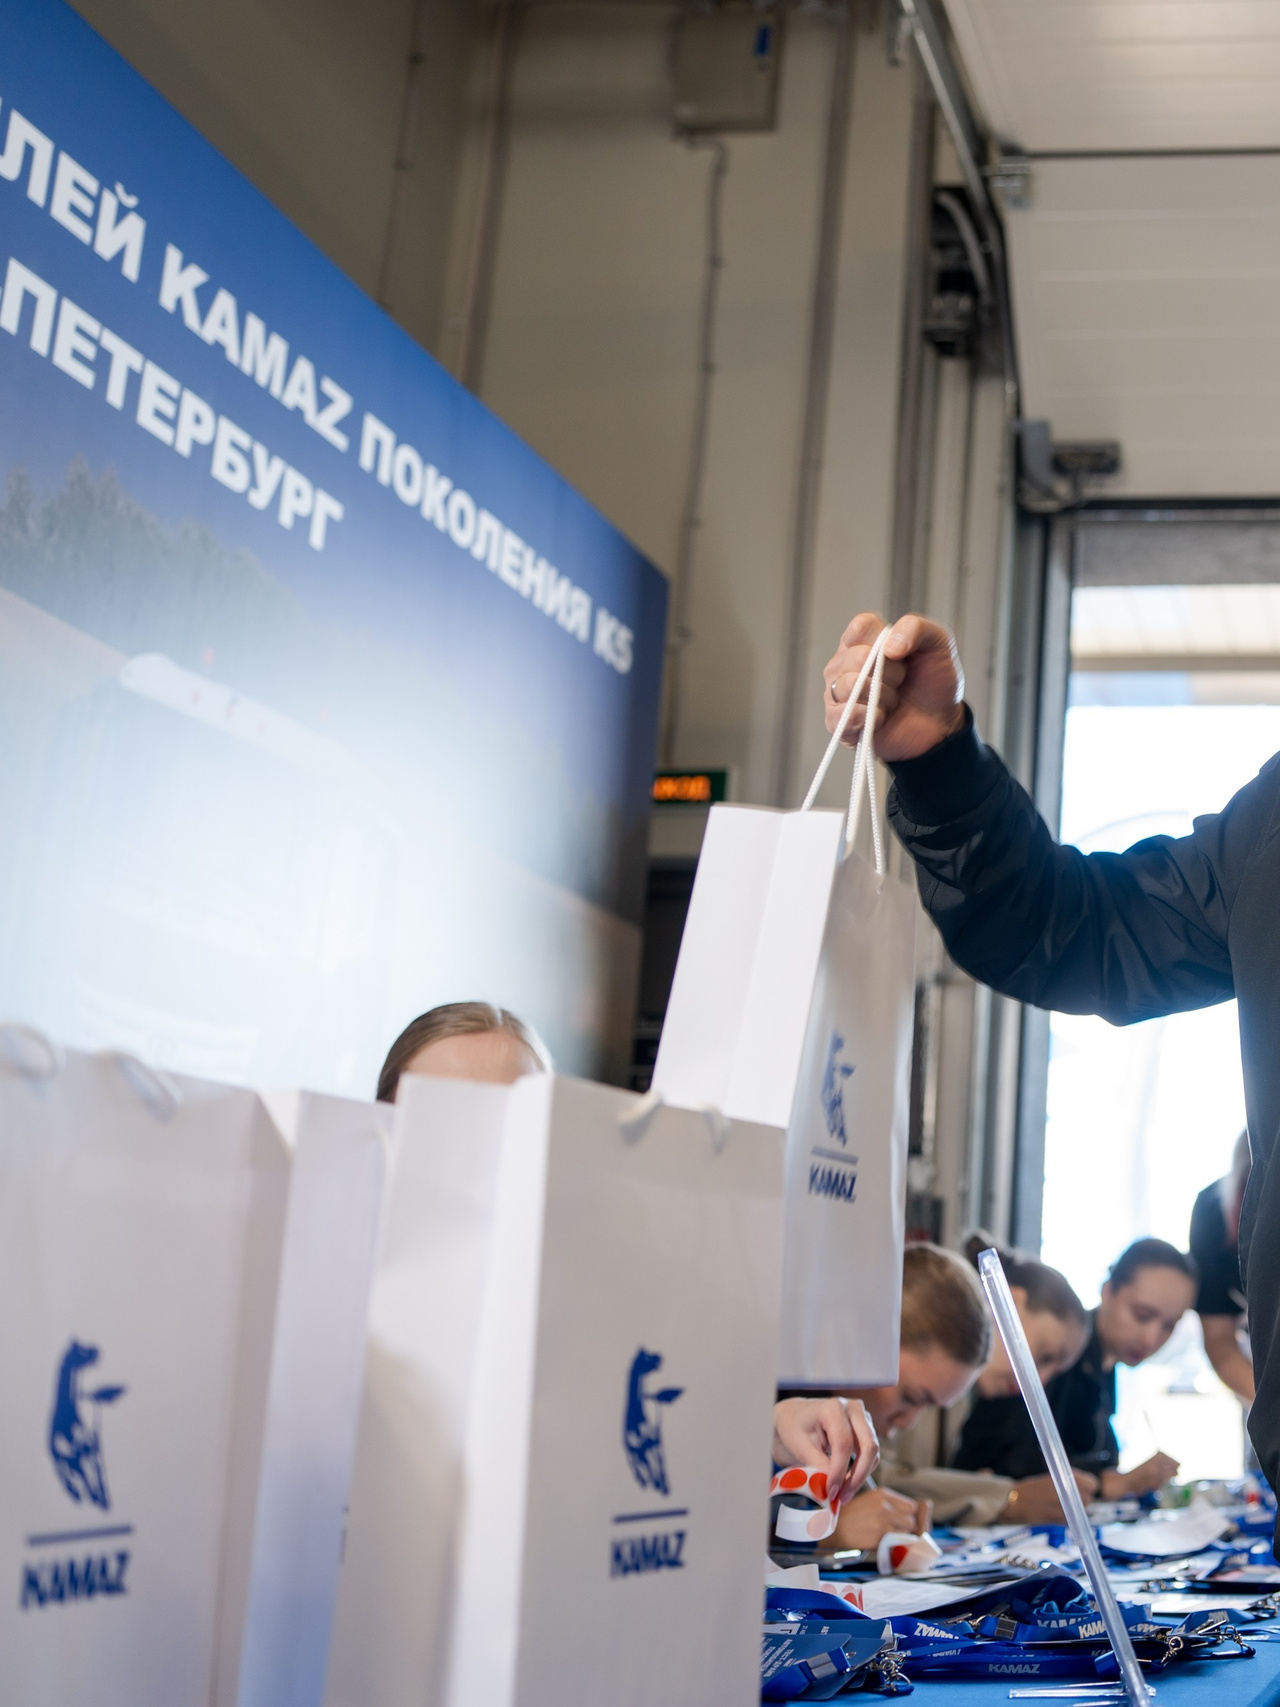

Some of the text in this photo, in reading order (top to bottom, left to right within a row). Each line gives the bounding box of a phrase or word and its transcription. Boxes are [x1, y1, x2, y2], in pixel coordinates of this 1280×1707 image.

[0, 107, 635, 675] ЛЕЙ KAMAZ ПОКОЛЕНИЯ K5
[0, 255, 344, 552] ПЕТЕРБУРГ
[807, 1162, 858, 1204] KAMAZ
[21, 1550, 132, 1612] KAMAZ
[609, 1530, 688, 1580] KAMAZ
[988, 1663, 1041, 1674] KAMAZ
